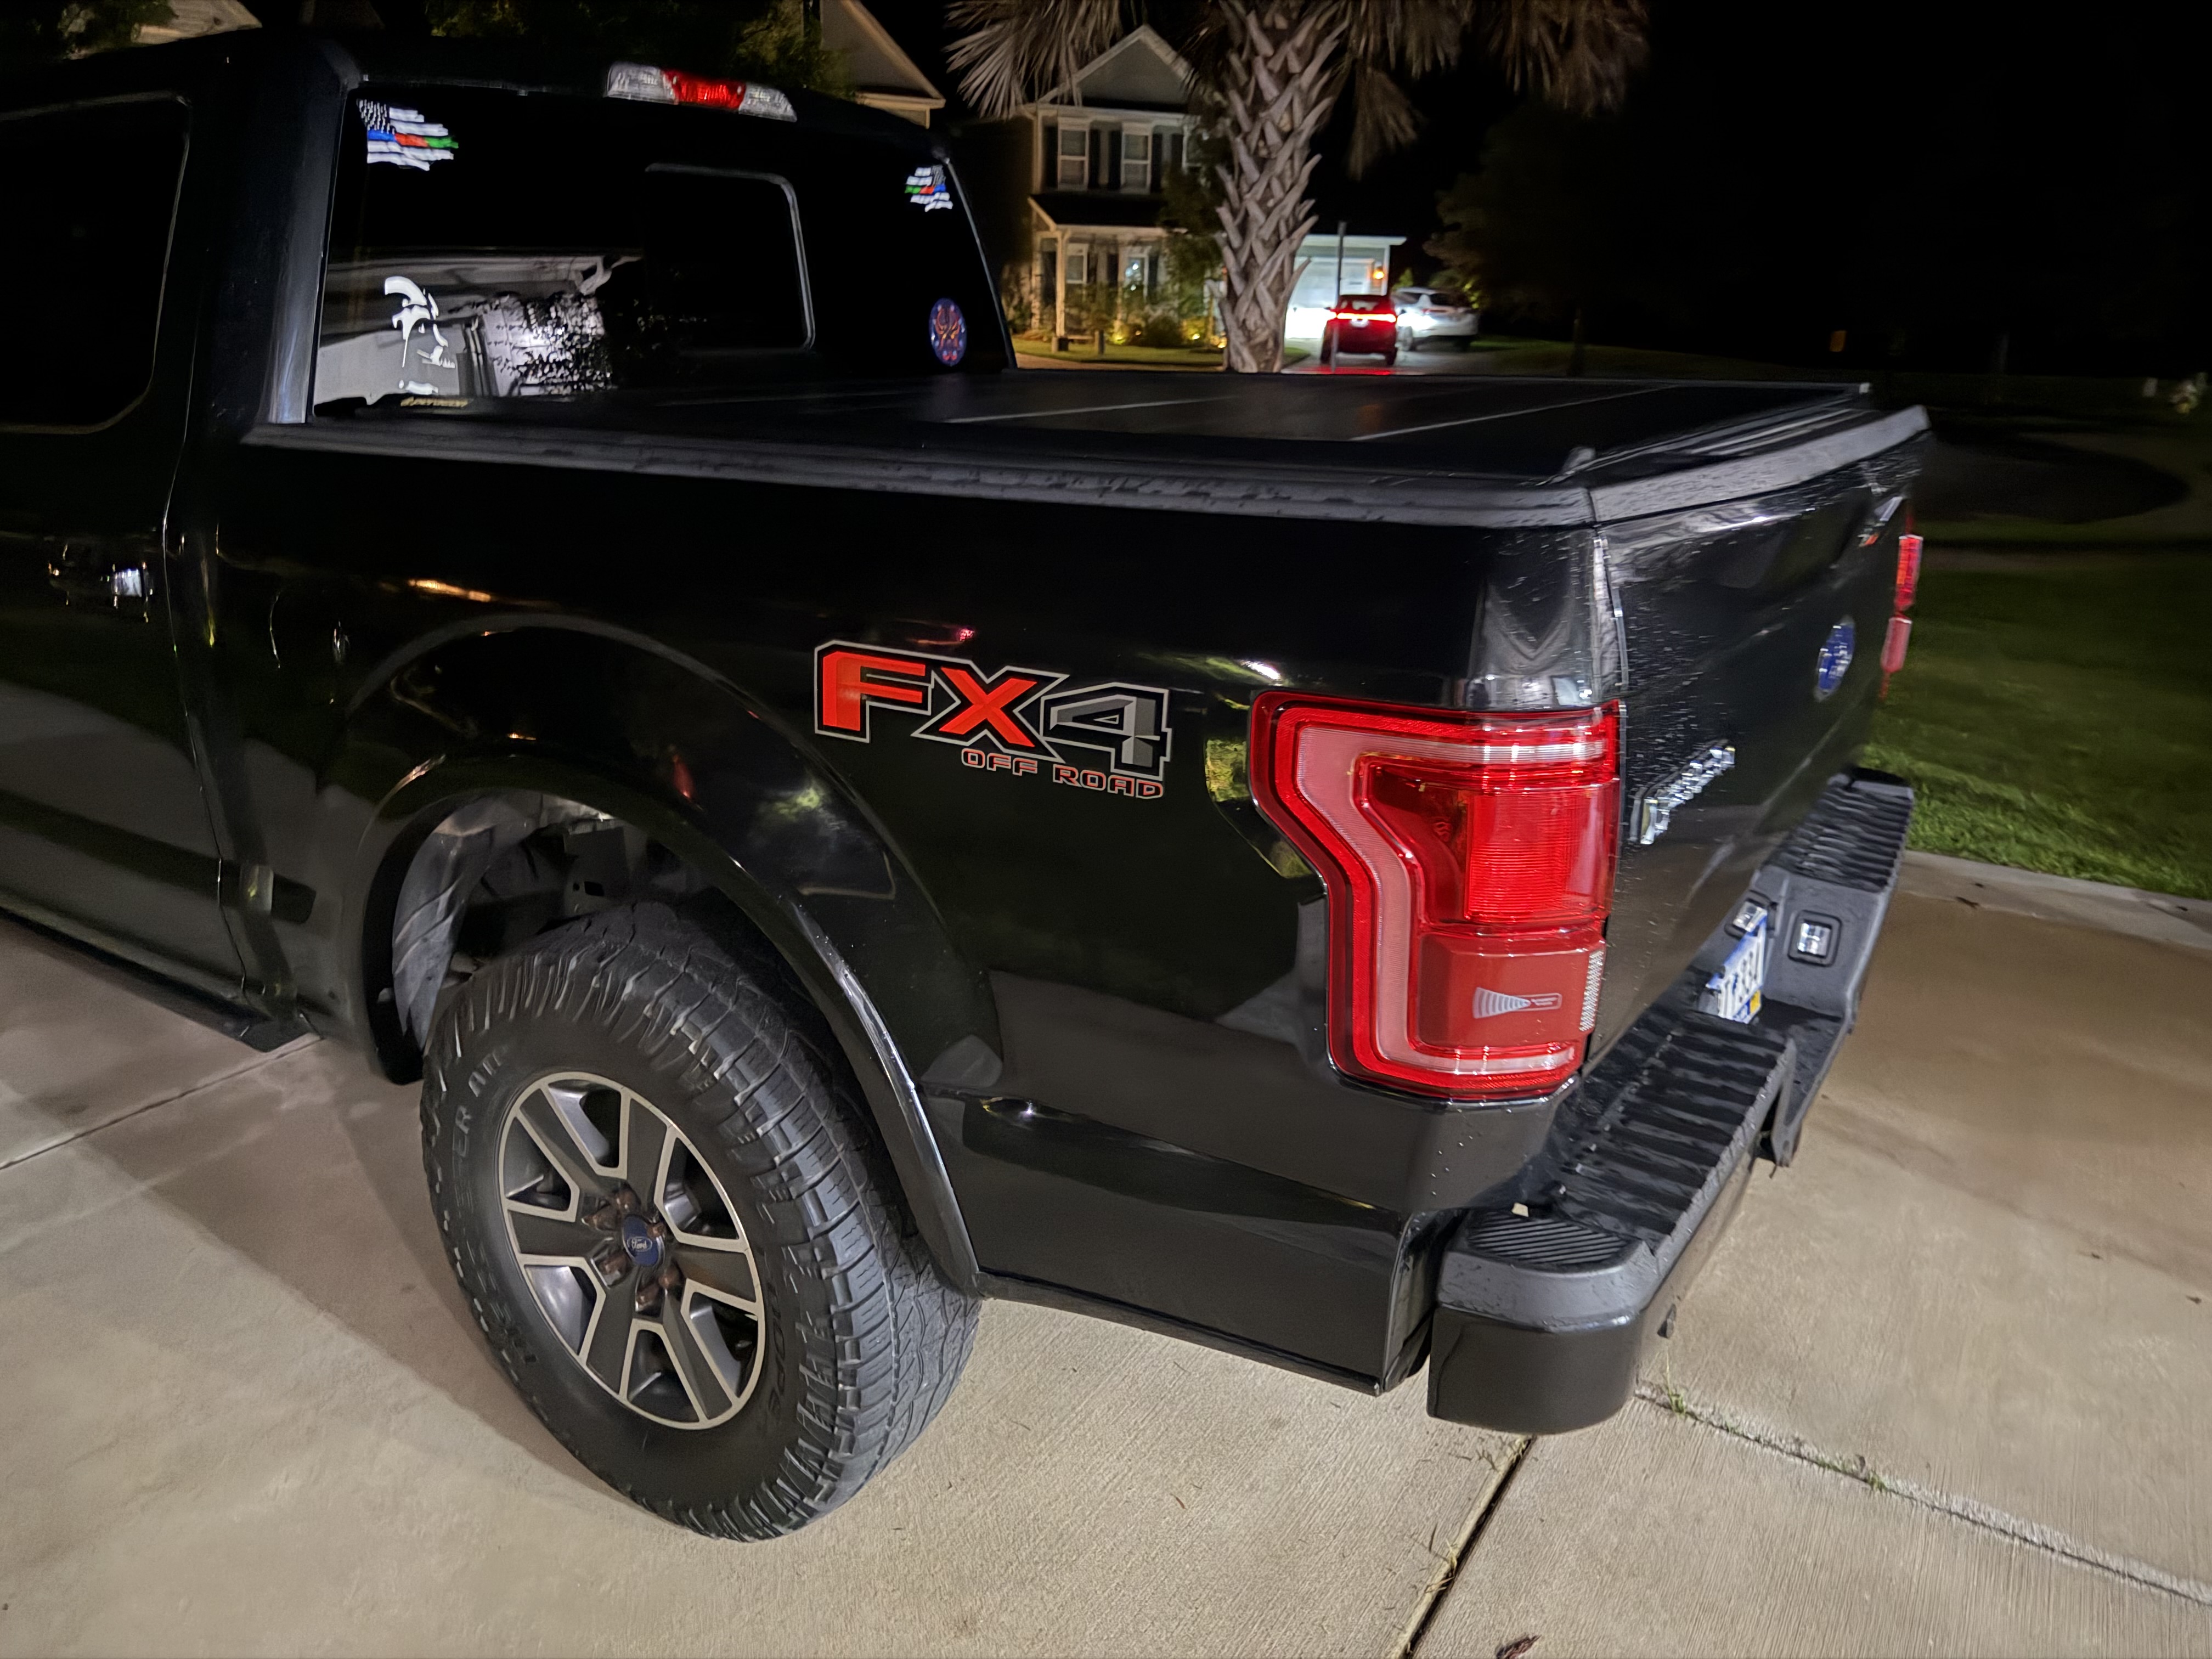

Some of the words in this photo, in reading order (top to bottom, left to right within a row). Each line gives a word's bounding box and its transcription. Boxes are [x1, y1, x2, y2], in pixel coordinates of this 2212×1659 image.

[815, 640, 1172, 781] FX4
[961, 748, 1039, 776] OFF
[1052, 764, 1164, 800] ROAD
